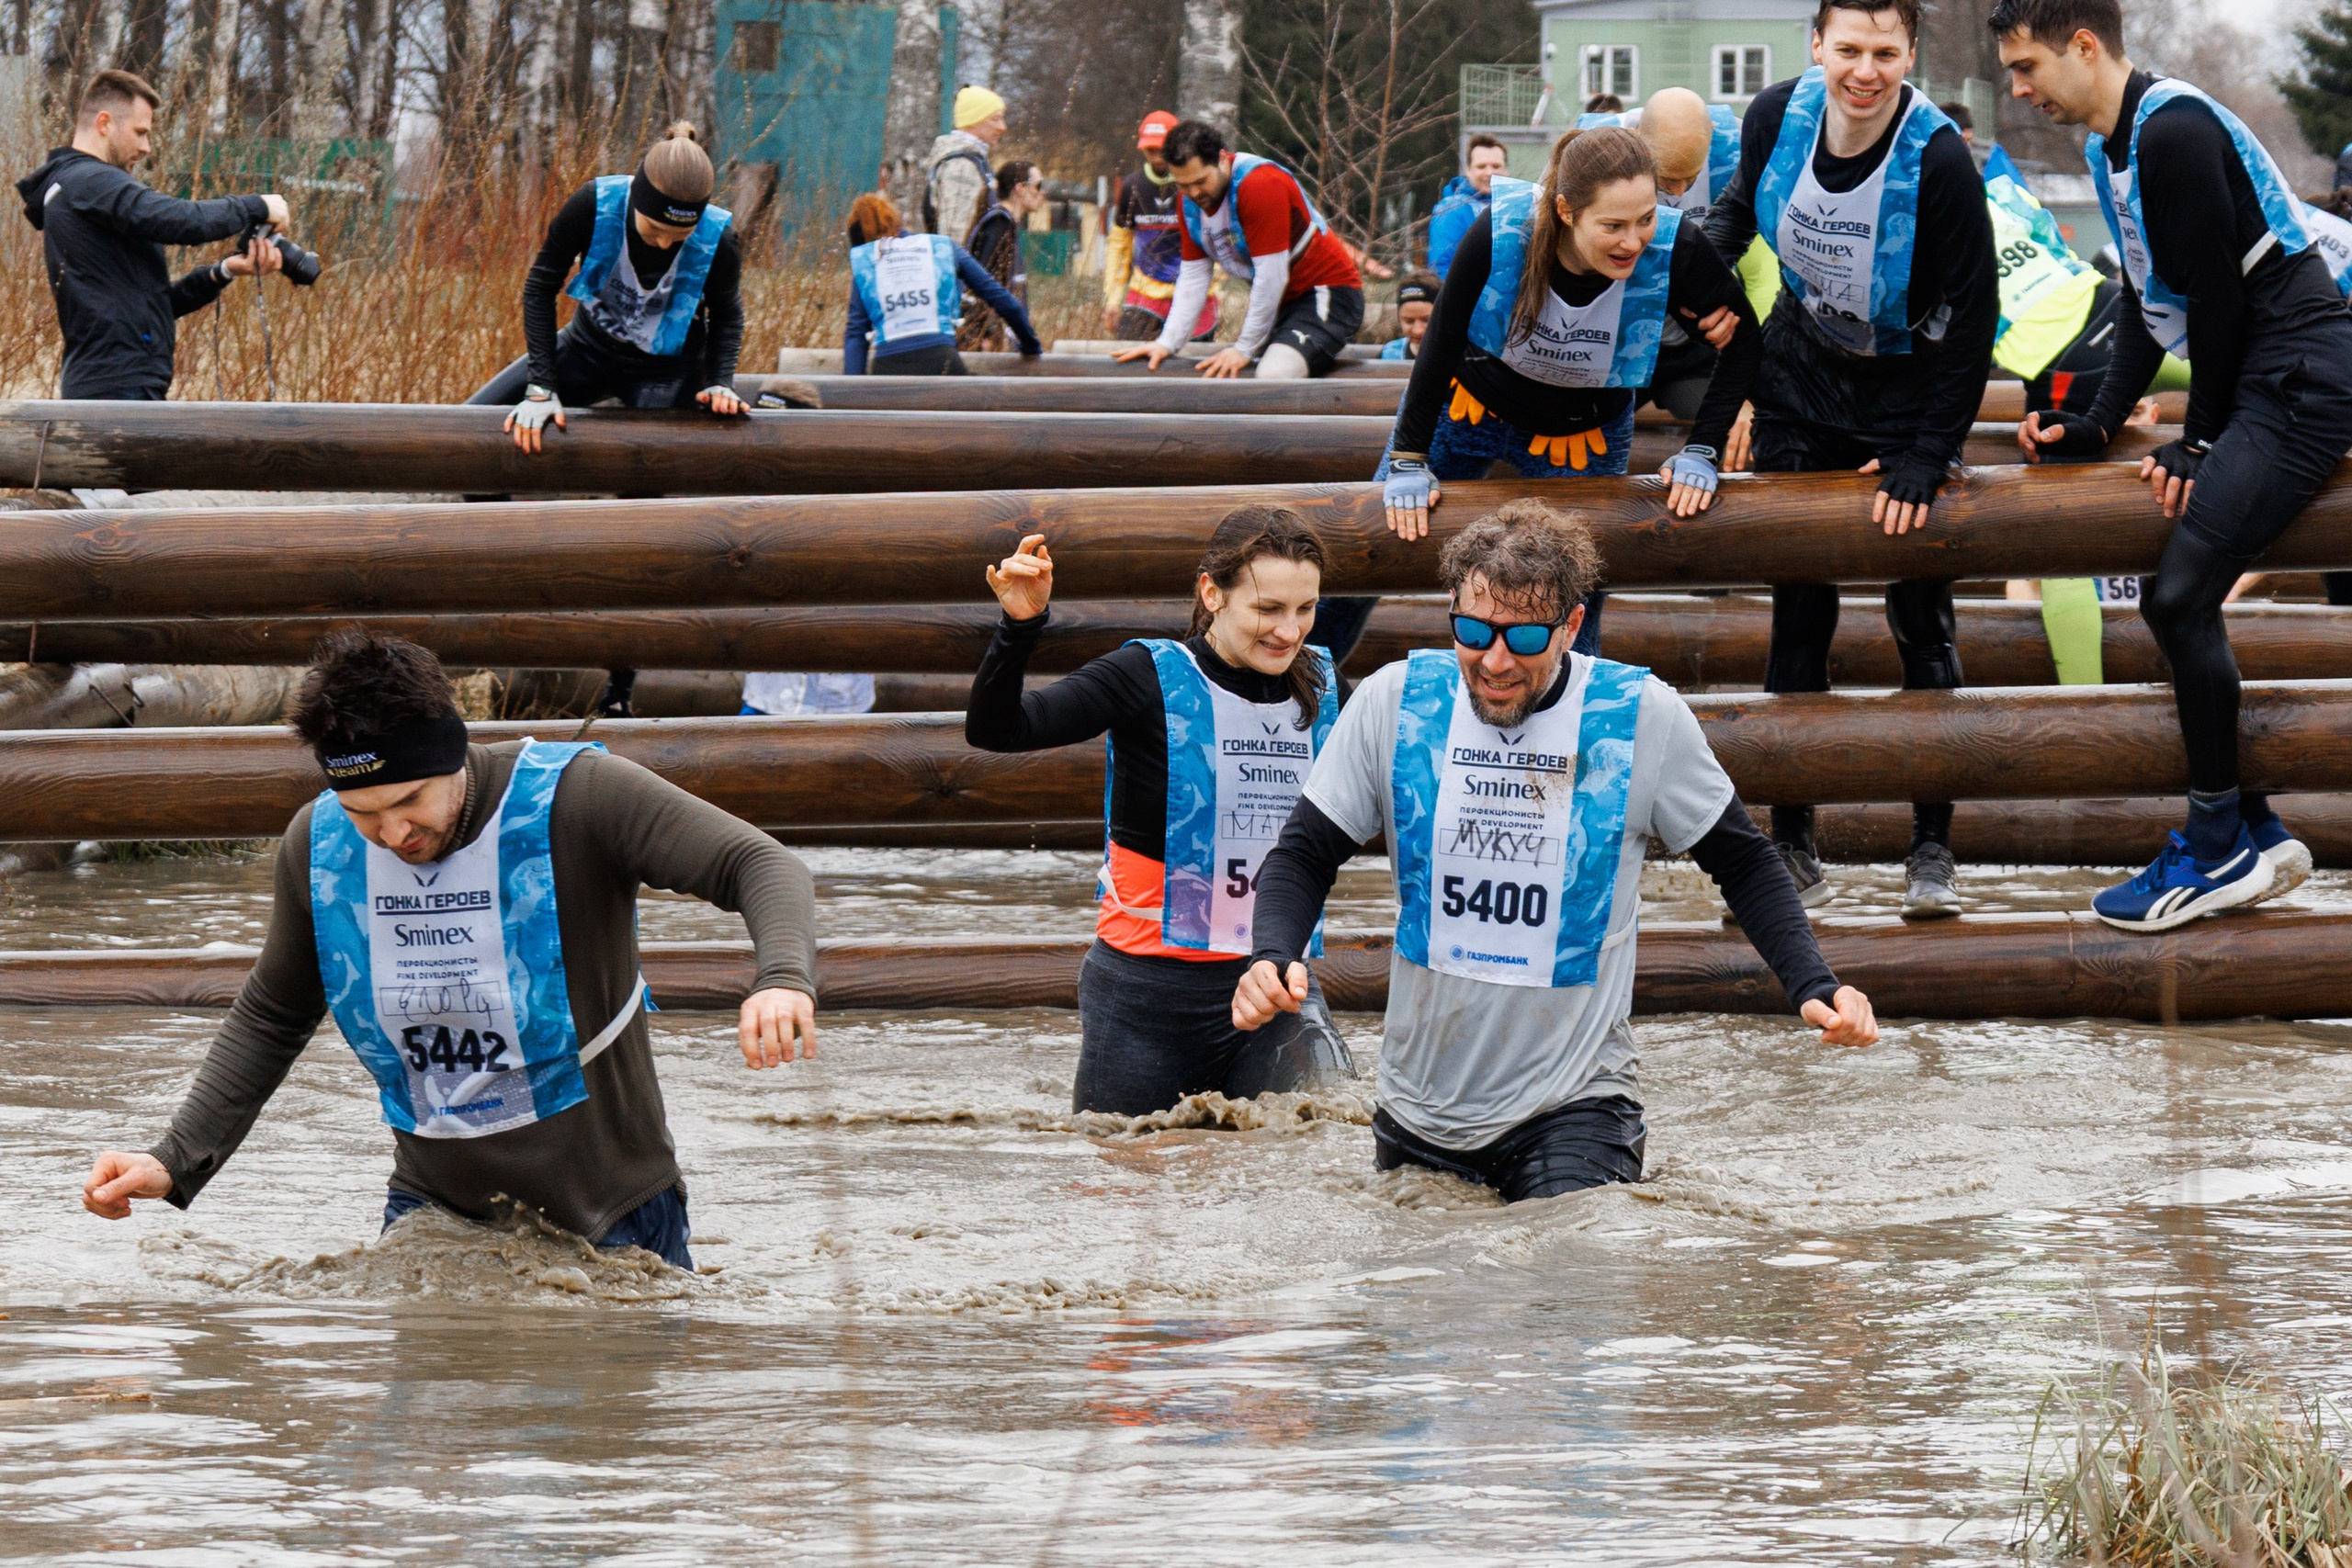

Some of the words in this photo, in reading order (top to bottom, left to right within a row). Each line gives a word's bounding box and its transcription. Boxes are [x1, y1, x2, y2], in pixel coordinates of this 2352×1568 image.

[1788, 203, 1819, 229] ГОНКА
[1822, 220, 1871, 235] ГЕРОЕВ
[1792, 229, 1854, 258] Sminex
[885, 288, 931, 312] 5455
[1564, 329, 1611, 341] ГЕРОЕВ
[1525, 339, 1593, 362] Sminex
[1223, 739, 1267, 752] ГОНКА
[1270, 740, 1308, 755] ГЕРОЕВ
[1453, 747, 1502, 764] ГОНКА
[1507, 751, 1568, 769] ГЕРОЕВ
[325, 750, 379, 768] Sminex
[1238, 762, 1300, 784] Sminex
[1463, 773, 1547, 801] Sminex
[1458, 817, 1477, 826] FINE
[1480, 818, 1544, 830] DEVELOPMENT
[1459, 807, 1545, 820] ПЕРФЕКЦИОНИСТЫ
[375, 895, 422, 910] ГОНКА
[425, 890, 491, 908] ГЕРОЕВ
[1442, 874, 1548, 928] 5400
[394, 923, 475, 947] Sminex
[396, 956, 478, 968] ПЕРФЕКЦИОНИСТЫ
[1466, 950, 1529, 966] ГАЗПРОМБАНК
[419, 969, 479, 980] DEVELOPMENT
[401, 1023, 510, 1073] 5442
